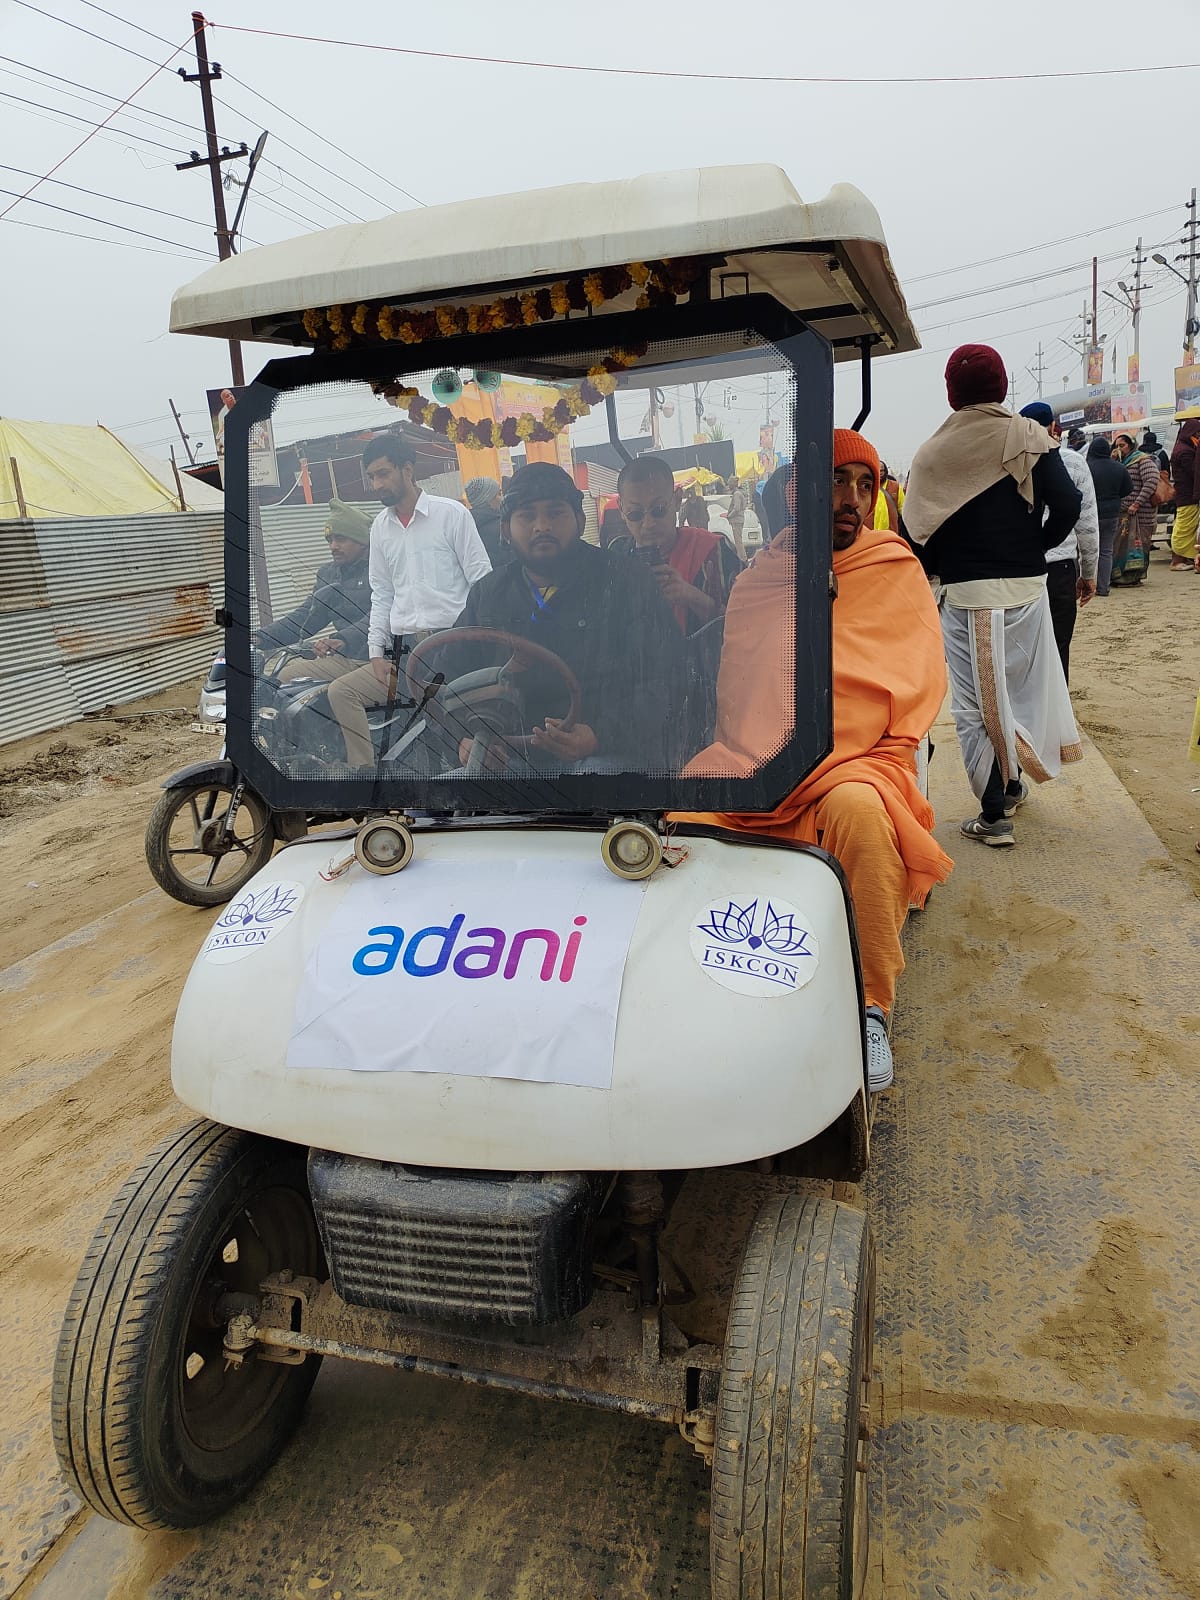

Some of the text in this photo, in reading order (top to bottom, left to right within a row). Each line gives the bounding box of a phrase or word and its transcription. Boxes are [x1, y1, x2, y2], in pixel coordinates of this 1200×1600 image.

[206, 930, 271, 950] ISKCON
[352, 913, 588, 983] adani
[703, 949, 799, 983] ISKCON
